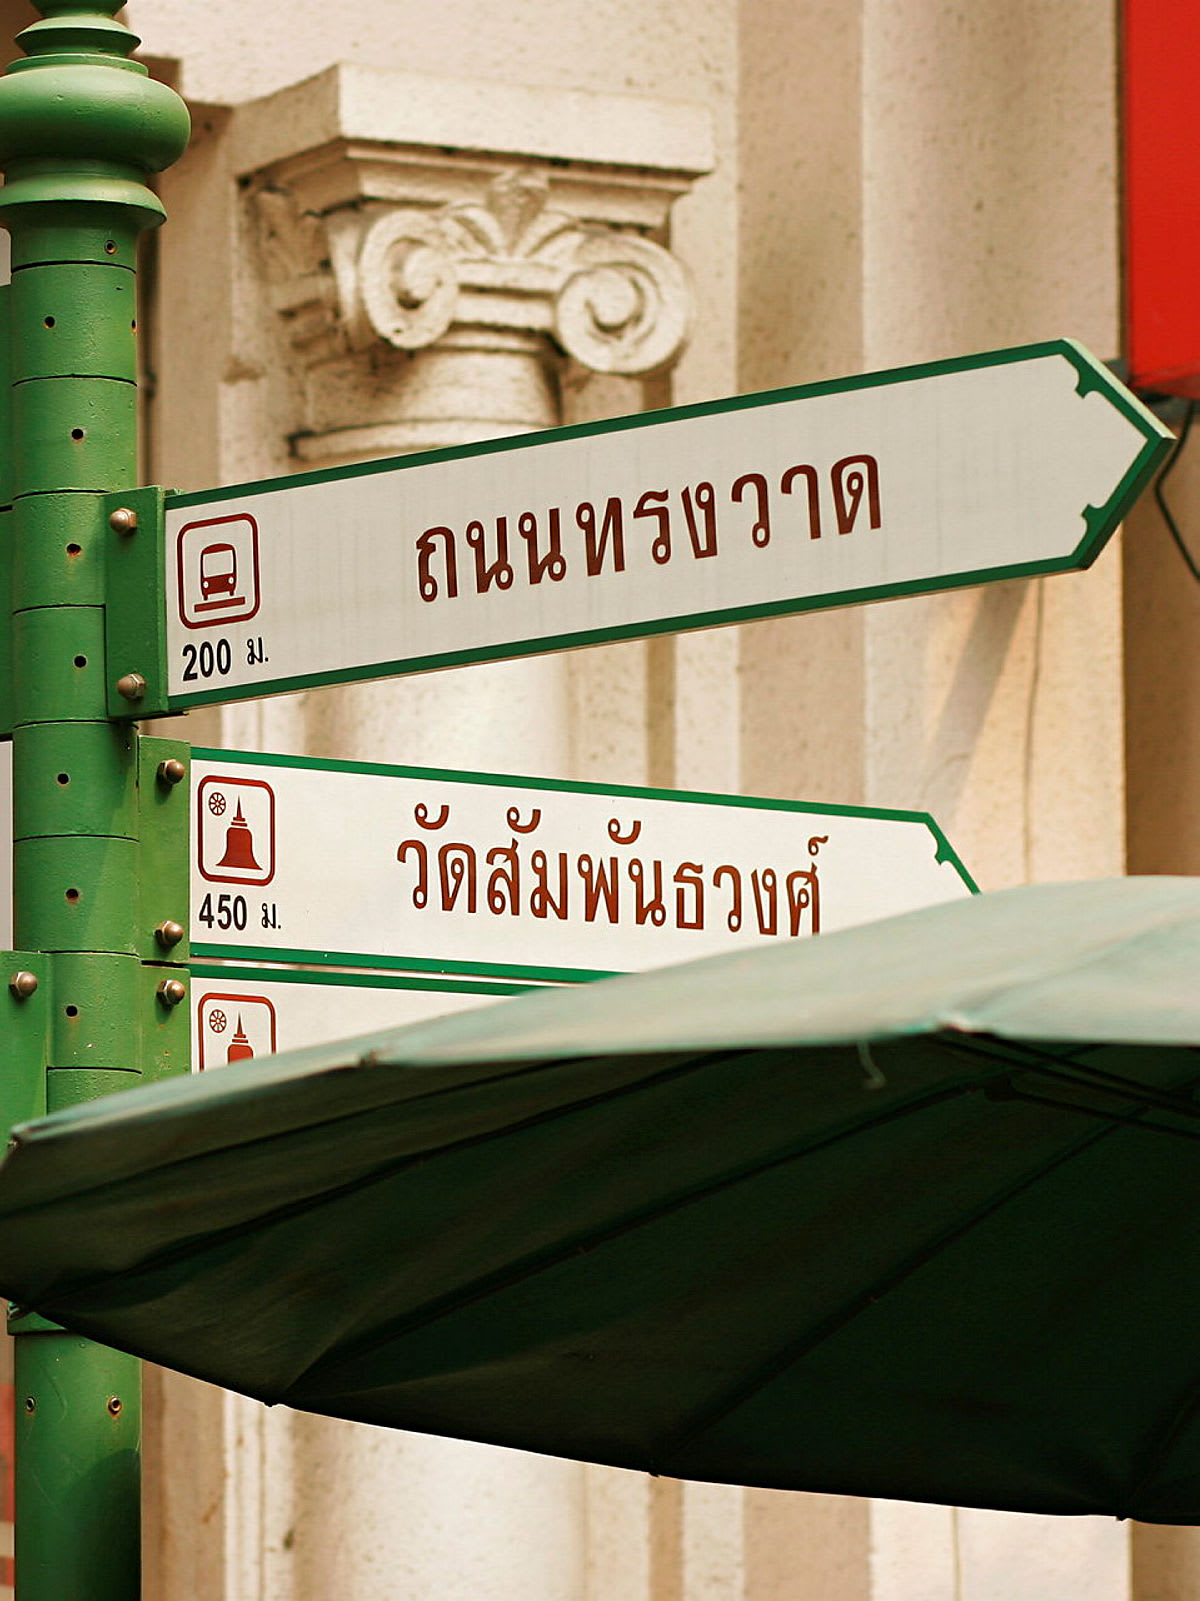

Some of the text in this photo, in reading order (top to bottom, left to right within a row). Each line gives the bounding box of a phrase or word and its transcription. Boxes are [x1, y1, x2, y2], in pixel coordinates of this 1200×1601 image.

[415, 454, 882, 603] ถนนทรงวาด
[182, 637, 269, 681] 200 ม.
[198, 892, 282, 931] 450 ม.
[396, 801, 830, 936] วัดสัมพันธวงศ์
